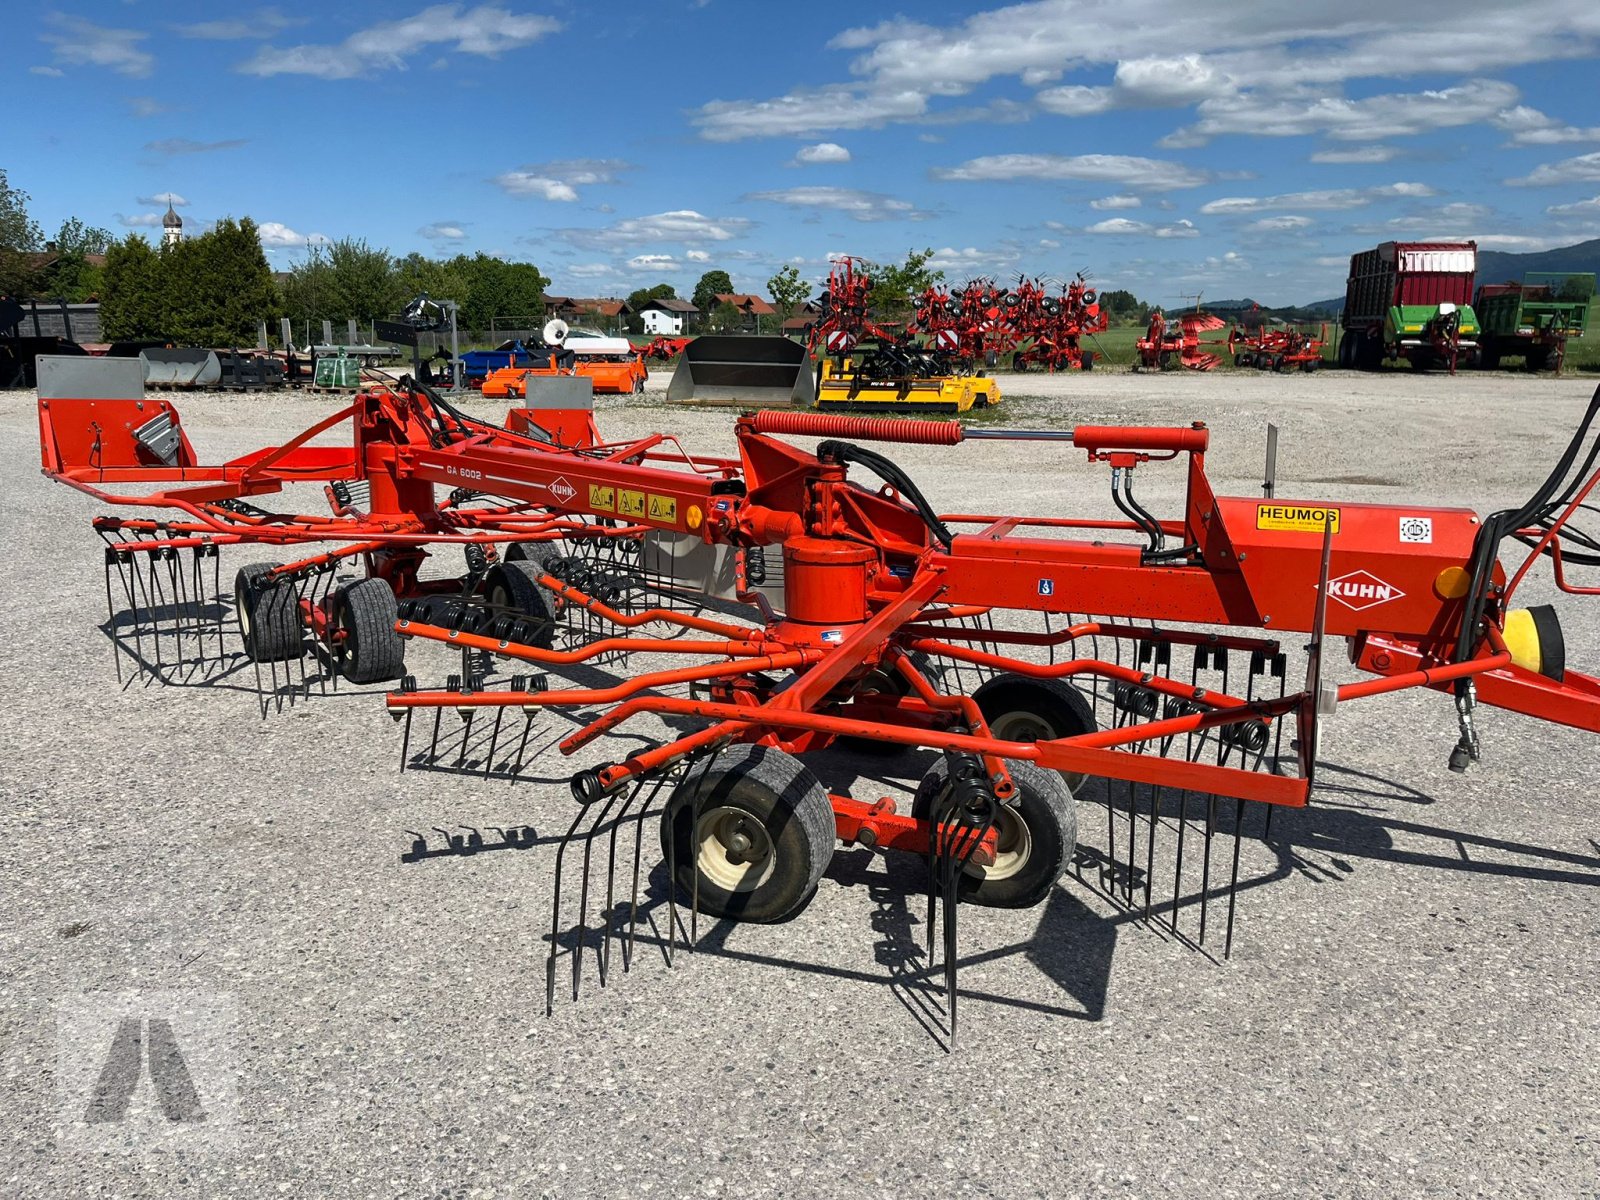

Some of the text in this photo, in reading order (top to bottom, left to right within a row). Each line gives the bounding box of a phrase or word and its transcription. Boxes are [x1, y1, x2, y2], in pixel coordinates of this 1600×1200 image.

[447, 465, 482, 480] GA 6002
[552, 484, 573, 496] KUHN
[1260, 507, 1337, 522] HEUMOS
[1328, 581, 1391, 600] KUHN
